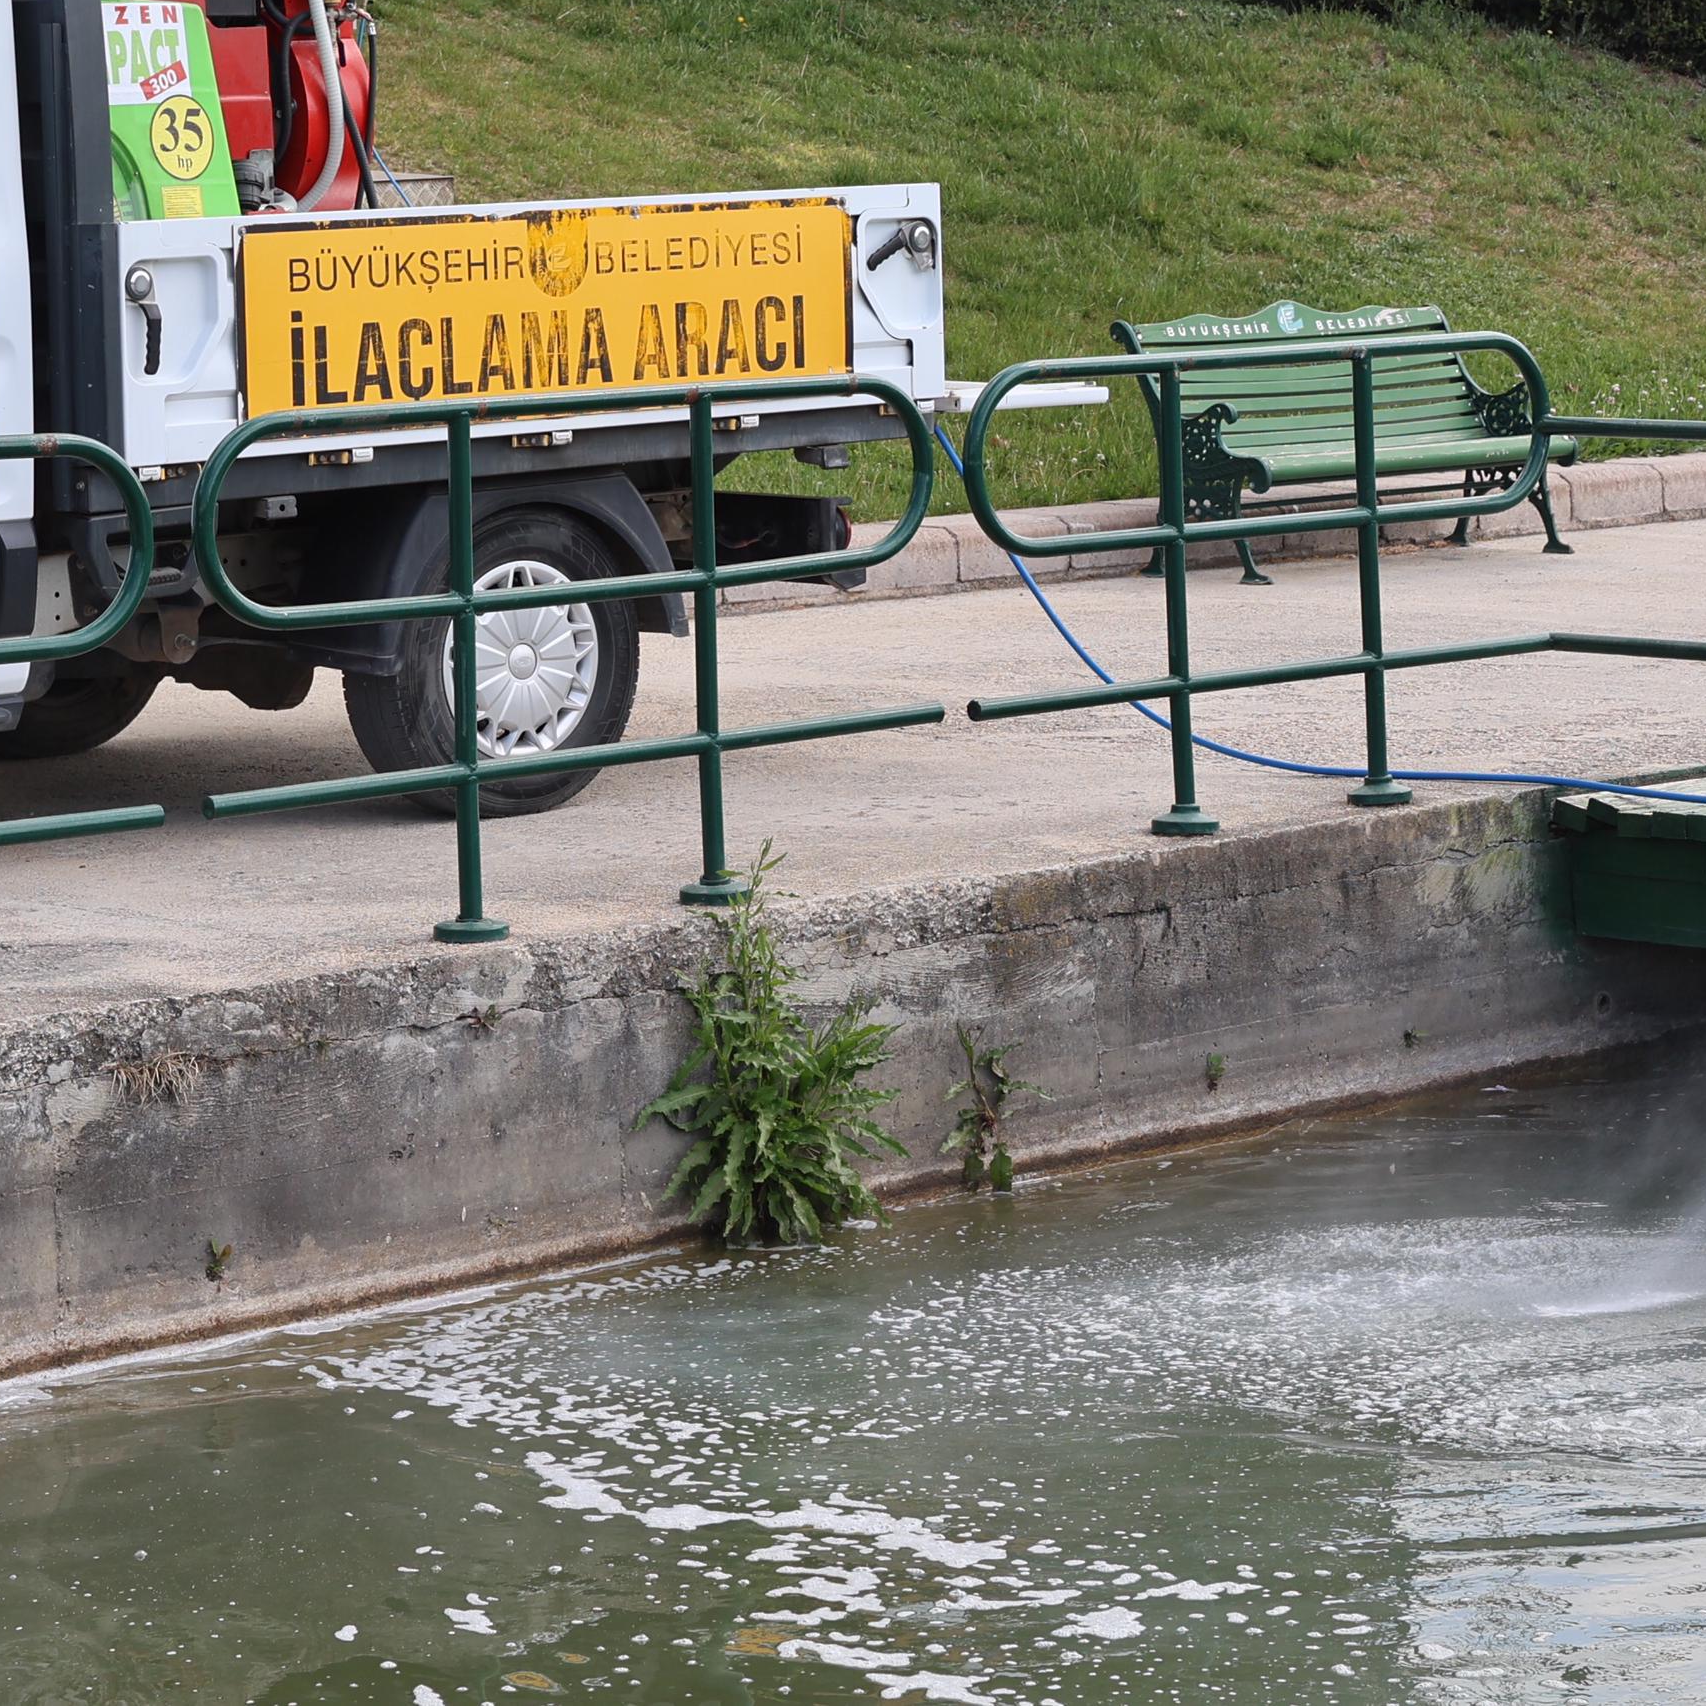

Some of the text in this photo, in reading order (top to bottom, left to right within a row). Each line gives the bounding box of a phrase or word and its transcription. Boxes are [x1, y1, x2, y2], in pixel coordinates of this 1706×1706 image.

[114, 5, 178, 25] ZEN
[105, 29, 180, 84] PACT
[149, 69, 177, 95] 300
[158, 107, 203, 152] 35
[177, 155, 193, 172] hp
[288, 223, 804, 296] BÜYÜKŞEHİR BELEDİYESİ
[1166, 322, 1270, 338] BÜYÜKŞEHİR
[291, 294, 806, 407] İLAÇLAMA ARACI
